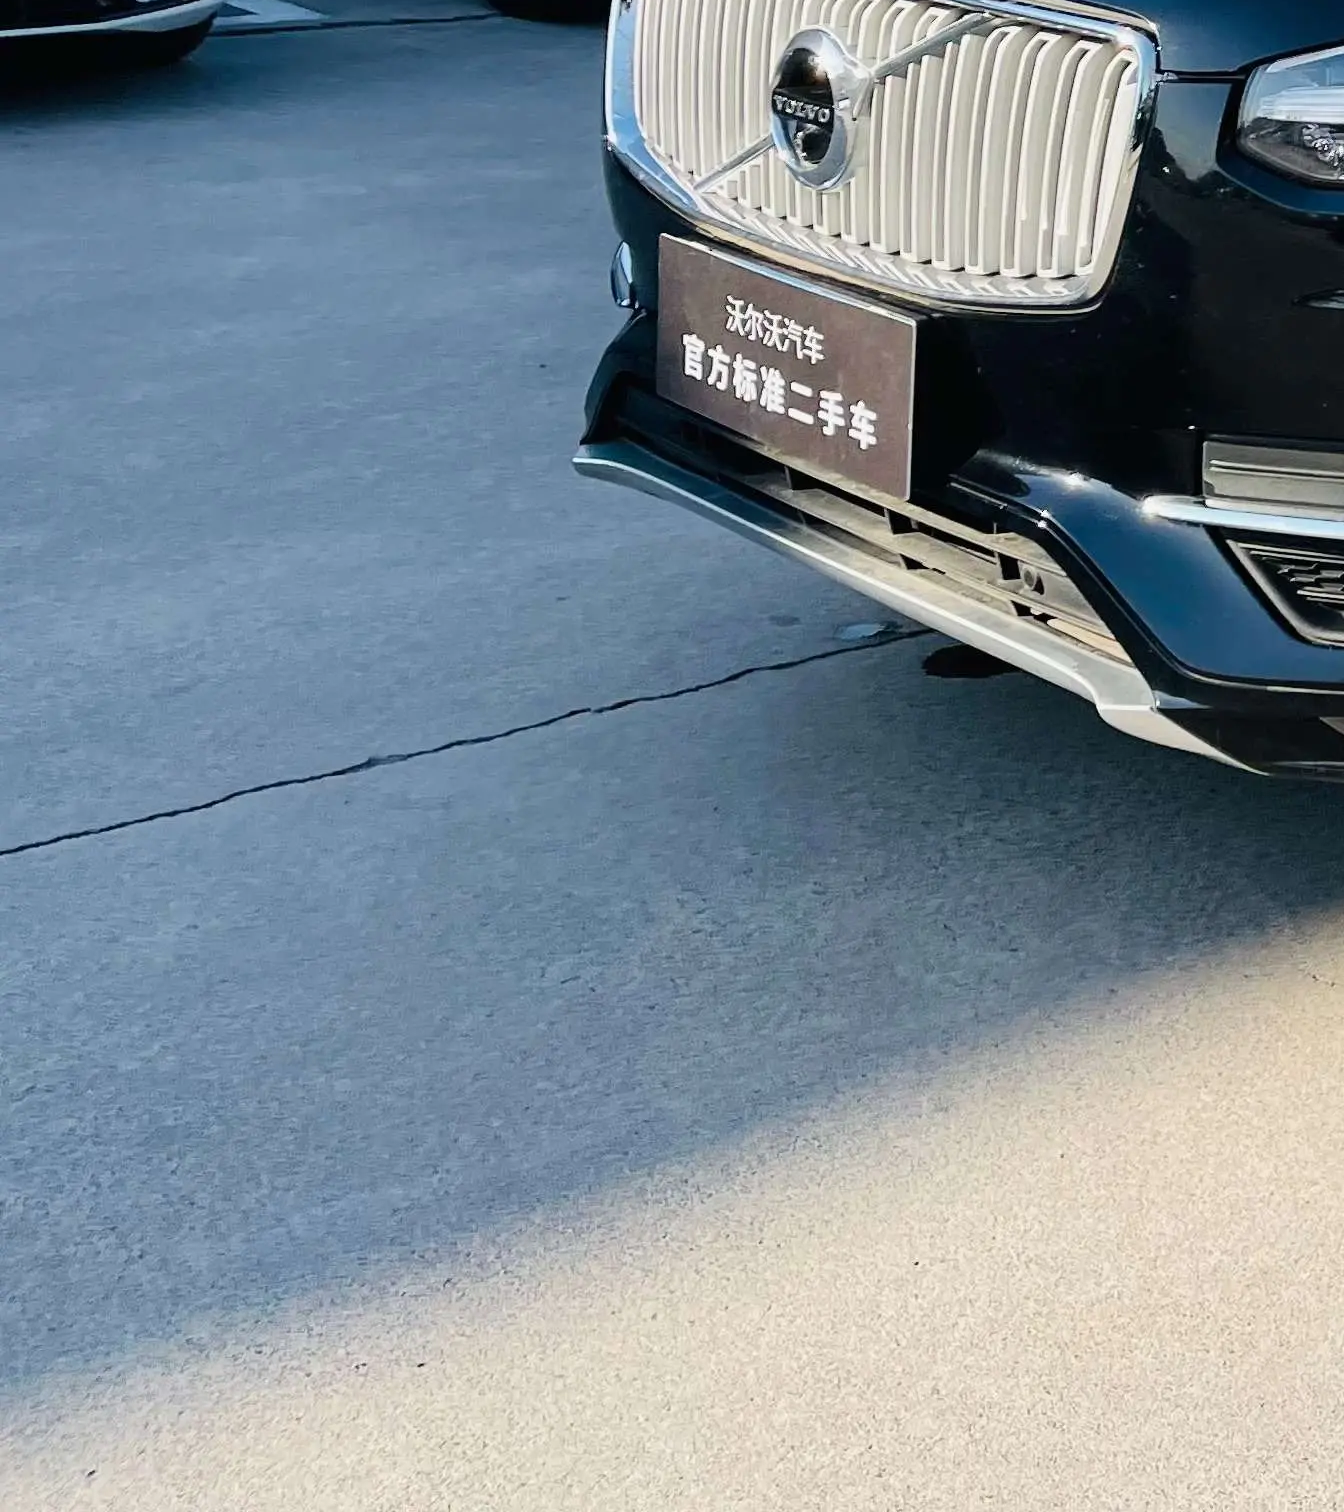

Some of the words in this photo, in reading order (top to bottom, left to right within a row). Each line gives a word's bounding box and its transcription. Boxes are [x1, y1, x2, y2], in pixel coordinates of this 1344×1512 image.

[773, 94, 831, 123] VOLVO
[725, 295, 825, 364] 沃尔沃汽车
[682, 333, 878, 450] 官方标准二手车
